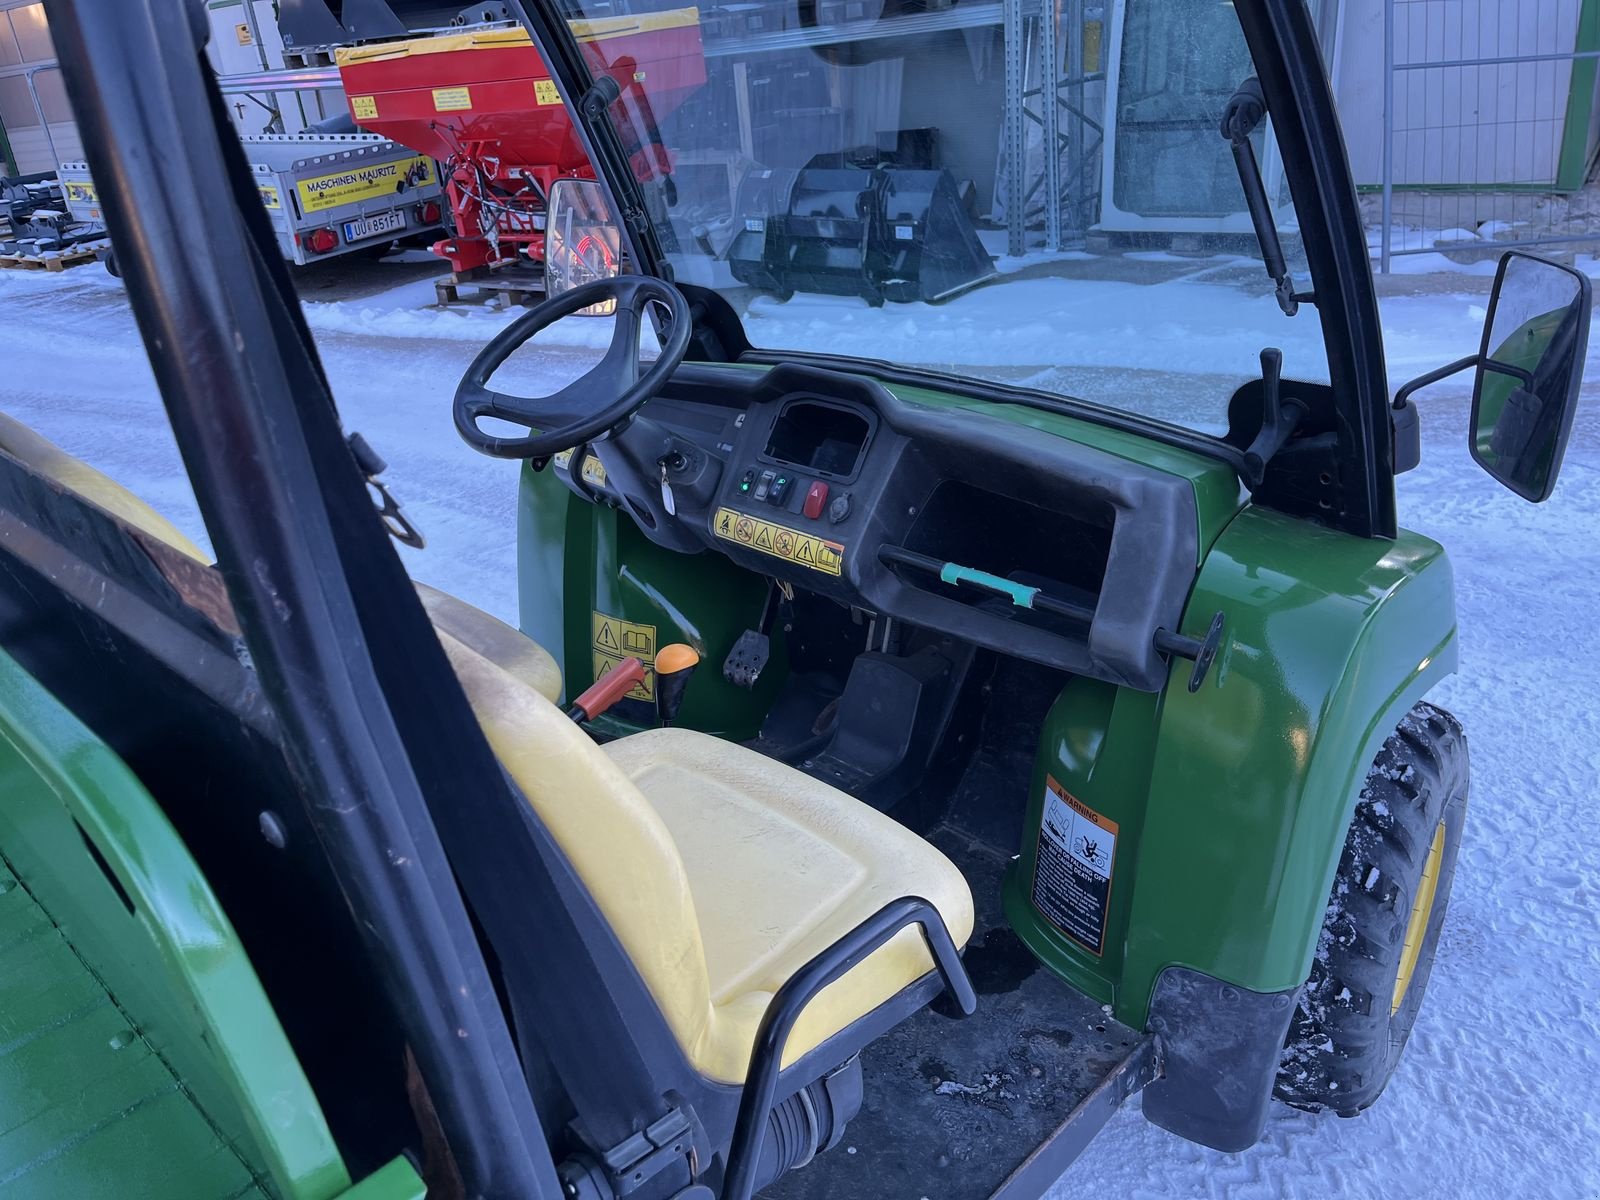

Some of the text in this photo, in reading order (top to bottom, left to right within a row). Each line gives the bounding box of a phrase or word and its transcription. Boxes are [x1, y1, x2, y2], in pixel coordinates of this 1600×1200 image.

[307, 174, 357, 193] MASCHINEN
[358, 165, 397, 182] MAURITZ
[354, 214, 401, 236] UU 851FT
[1063, 793, 1098, 823] WARNING
[1057, 854, 1073, 870] CAUSE
[1074, 867, 1093, 883] DEATH
[1071, 856, 1093, 876] FALLING
[1094, 872, 1107, 883] OFF
